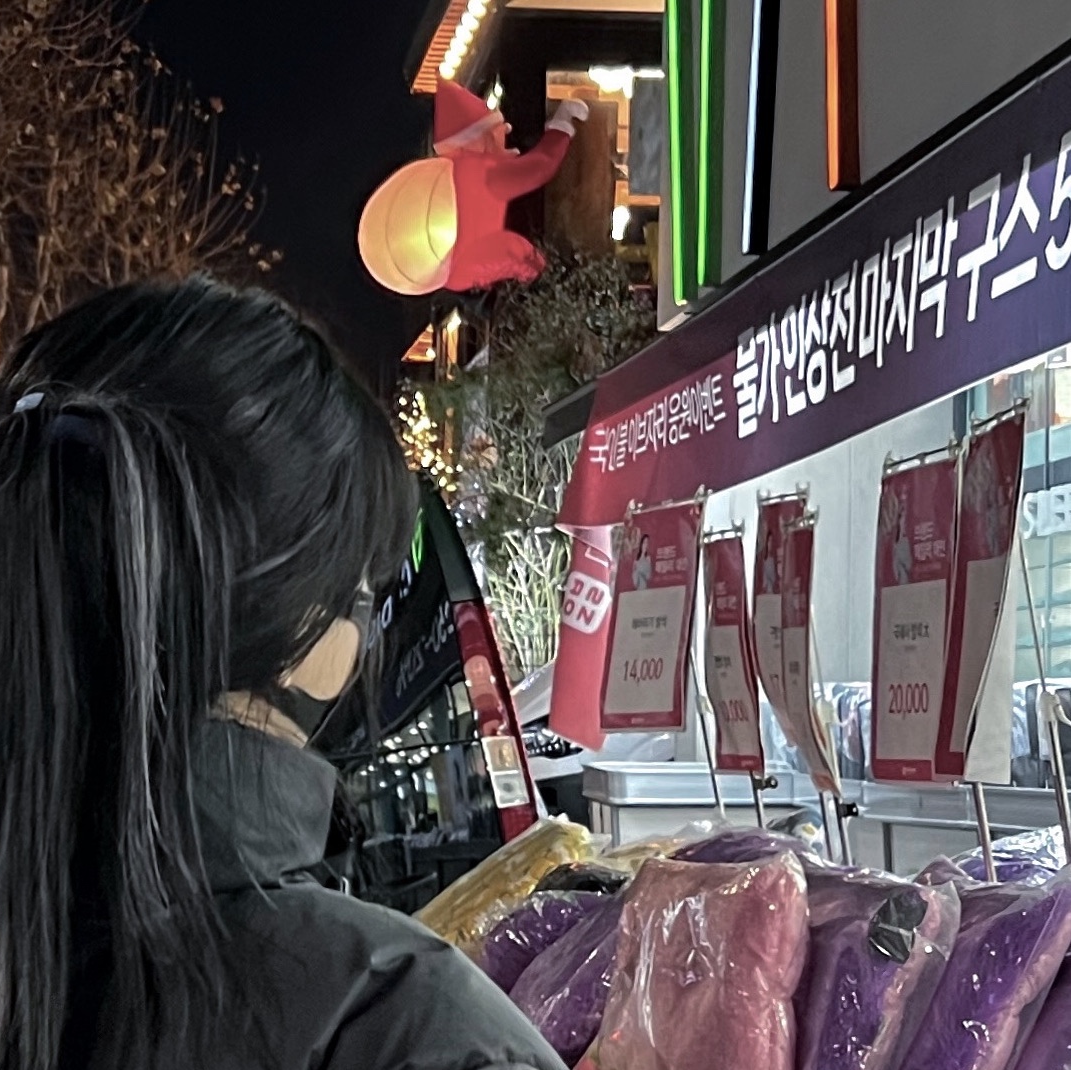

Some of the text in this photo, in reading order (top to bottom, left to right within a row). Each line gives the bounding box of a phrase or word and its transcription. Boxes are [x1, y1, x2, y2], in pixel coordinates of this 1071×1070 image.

[858, 196, 958, 369] 마지막
[623, 657, 664, 686] 14,000
[888, 682, 929, 719] 20,000
